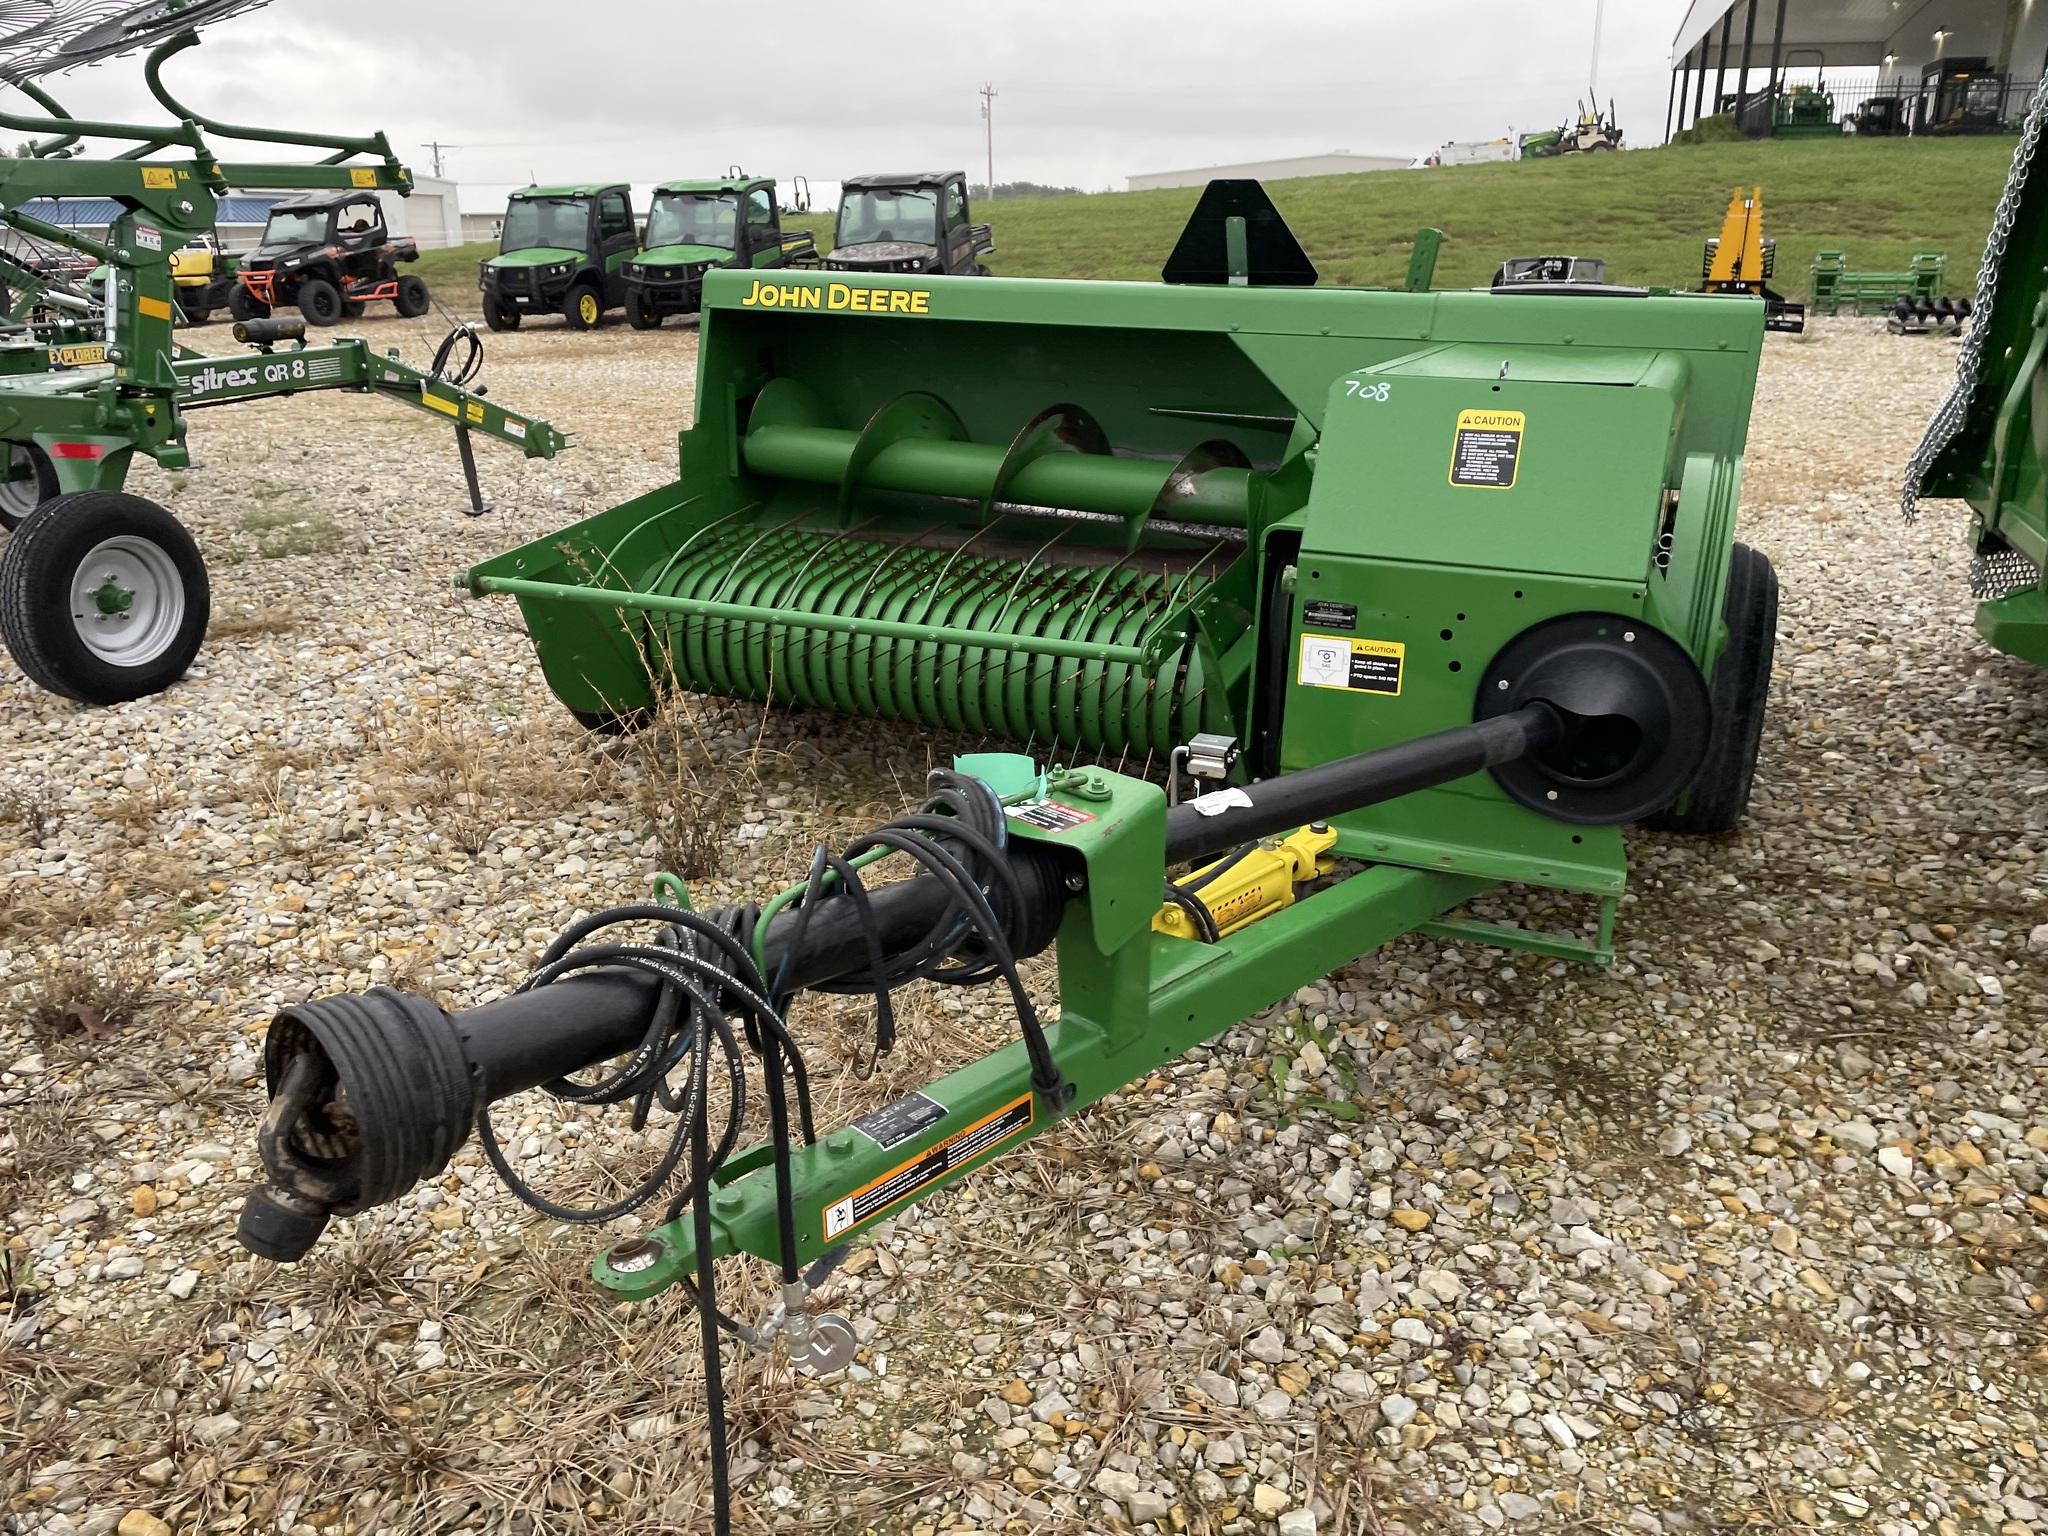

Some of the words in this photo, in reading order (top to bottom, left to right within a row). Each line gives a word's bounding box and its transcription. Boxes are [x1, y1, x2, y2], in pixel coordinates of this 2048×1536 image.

[742, 280, 821, 309] JOHN
[827, 283, 931, 313] DEERE
[48, 344, 105, 365] EXPLORER
[191, 366, 258, 395] sitrex
[264, 364, 289, 382] QR
[291, 360, 306, 379] 8
[1345, 380, 1391, 402] 708
[1474, 415, 1521, 426] CAUTION
[1364, 645, 1397, 654] CAUTION
[1056, 805, 1090, 820] DANGER
[930, 1130, 966, 1155] WARNING
